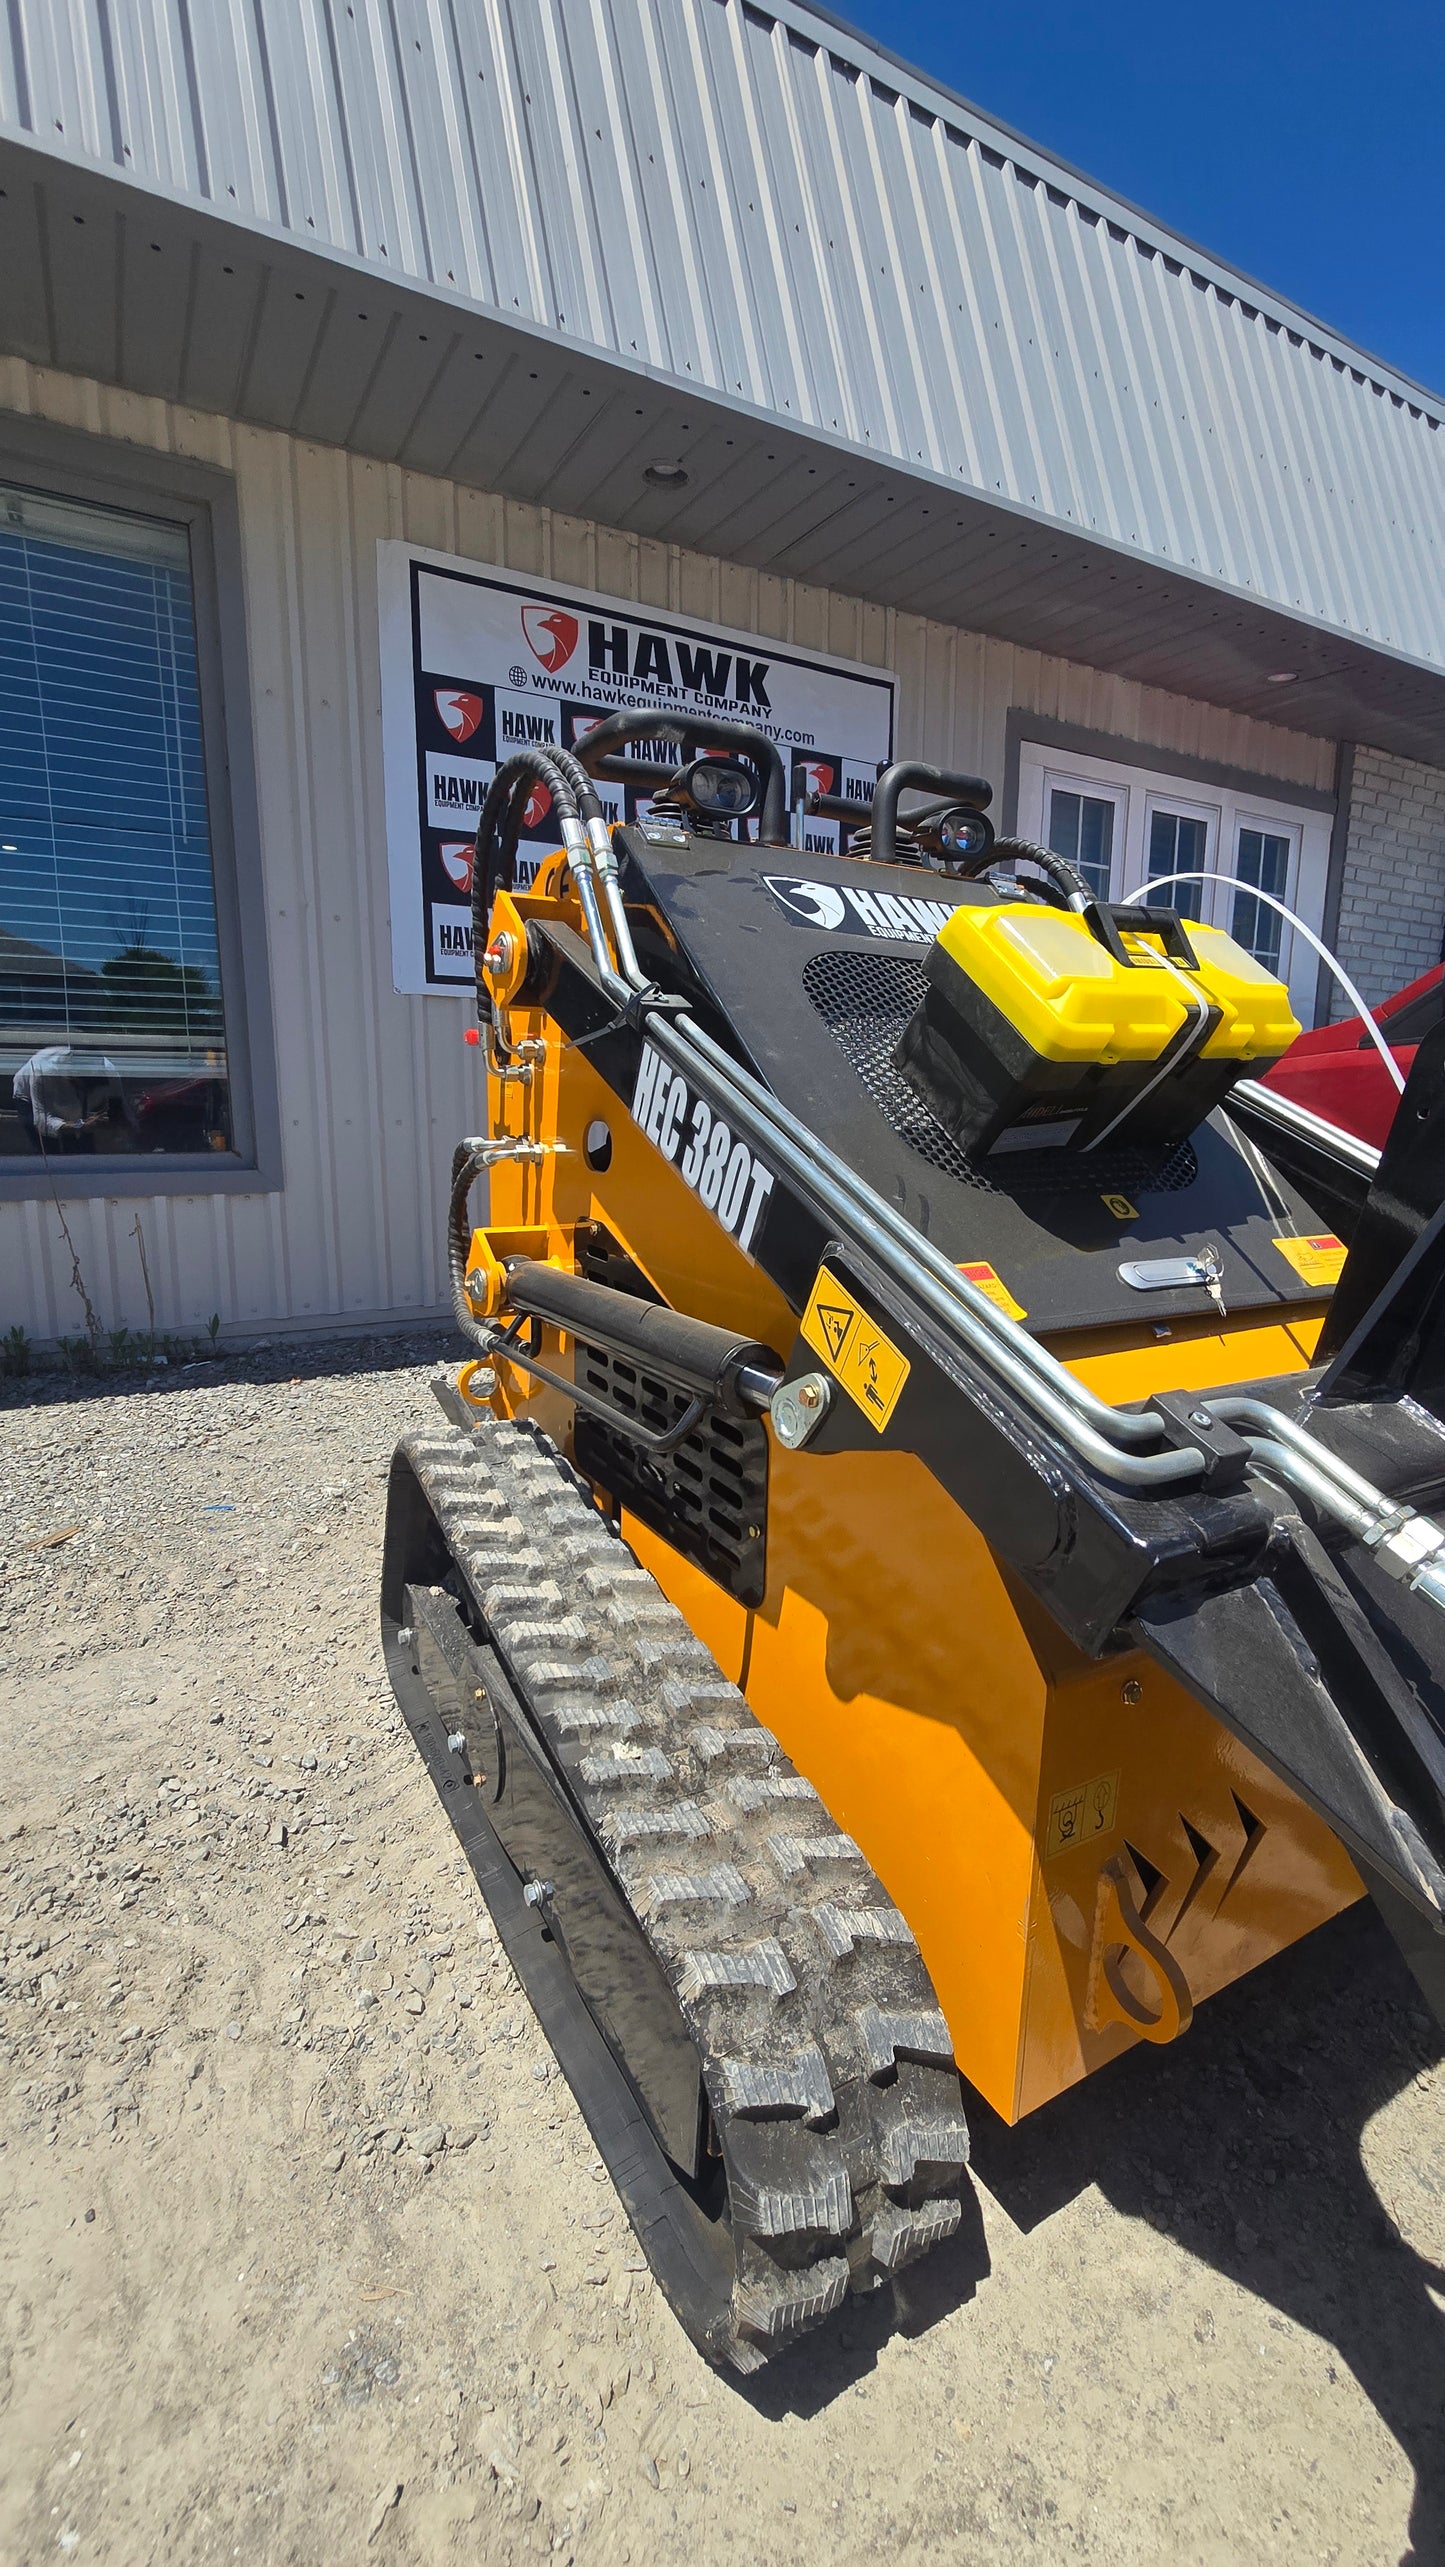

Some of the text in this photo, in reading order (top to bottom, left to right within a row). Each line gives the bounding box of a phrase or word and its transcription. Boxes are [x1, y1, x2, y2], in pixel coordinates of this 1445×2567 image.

[588, 620, 772, 707] HAWK
[588, 668, 773, 720] EQUIPMENT COMPANY
[502, 710, 555, 743] HAWK
[502, 735, 530, 746] EQUIPMENT
[846, 777, 877, 802] HAW
[435, 799, 464, 810] EQUIPMENT
[805, 833, 834, 855] AWK
[440, 948, 468, 957] EQUIPMENT
[631, 1041, 775, 1254] HEC 380T
